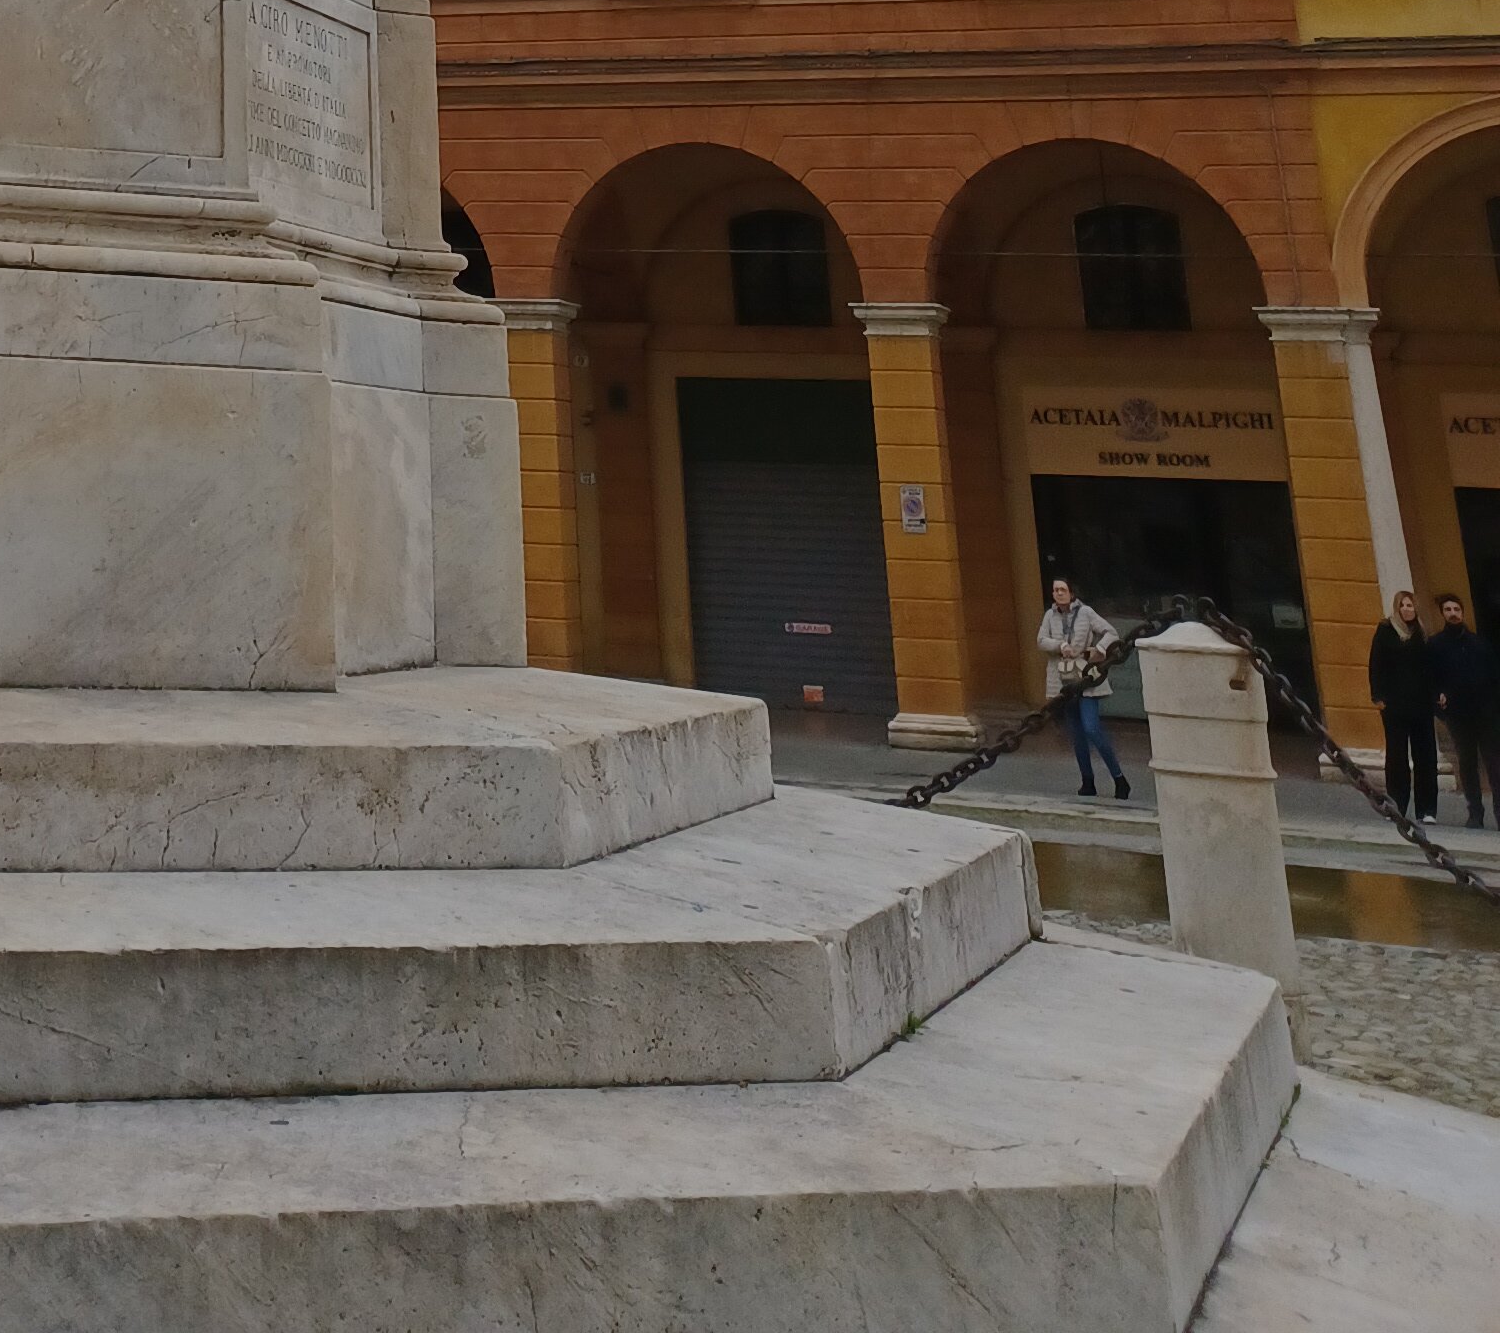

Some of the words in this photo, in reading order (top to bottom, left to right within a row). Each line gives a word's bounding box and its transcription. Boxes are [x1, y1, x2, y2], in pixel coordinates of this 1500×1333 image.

[248, 1, 257, 25] A
[260, 4, 288, 37] CIRO
[295, 18, 349, 60] MENOTTI
[251, 69, 276, 95] DELLA
[1029, 407, 1121, 428] ACETAIA
[1161, 410, 1275, 431] MALPIGHI
[1098, 450, 1151, 467] SHOW
[1156, 452, 1212, 468] ROOM
